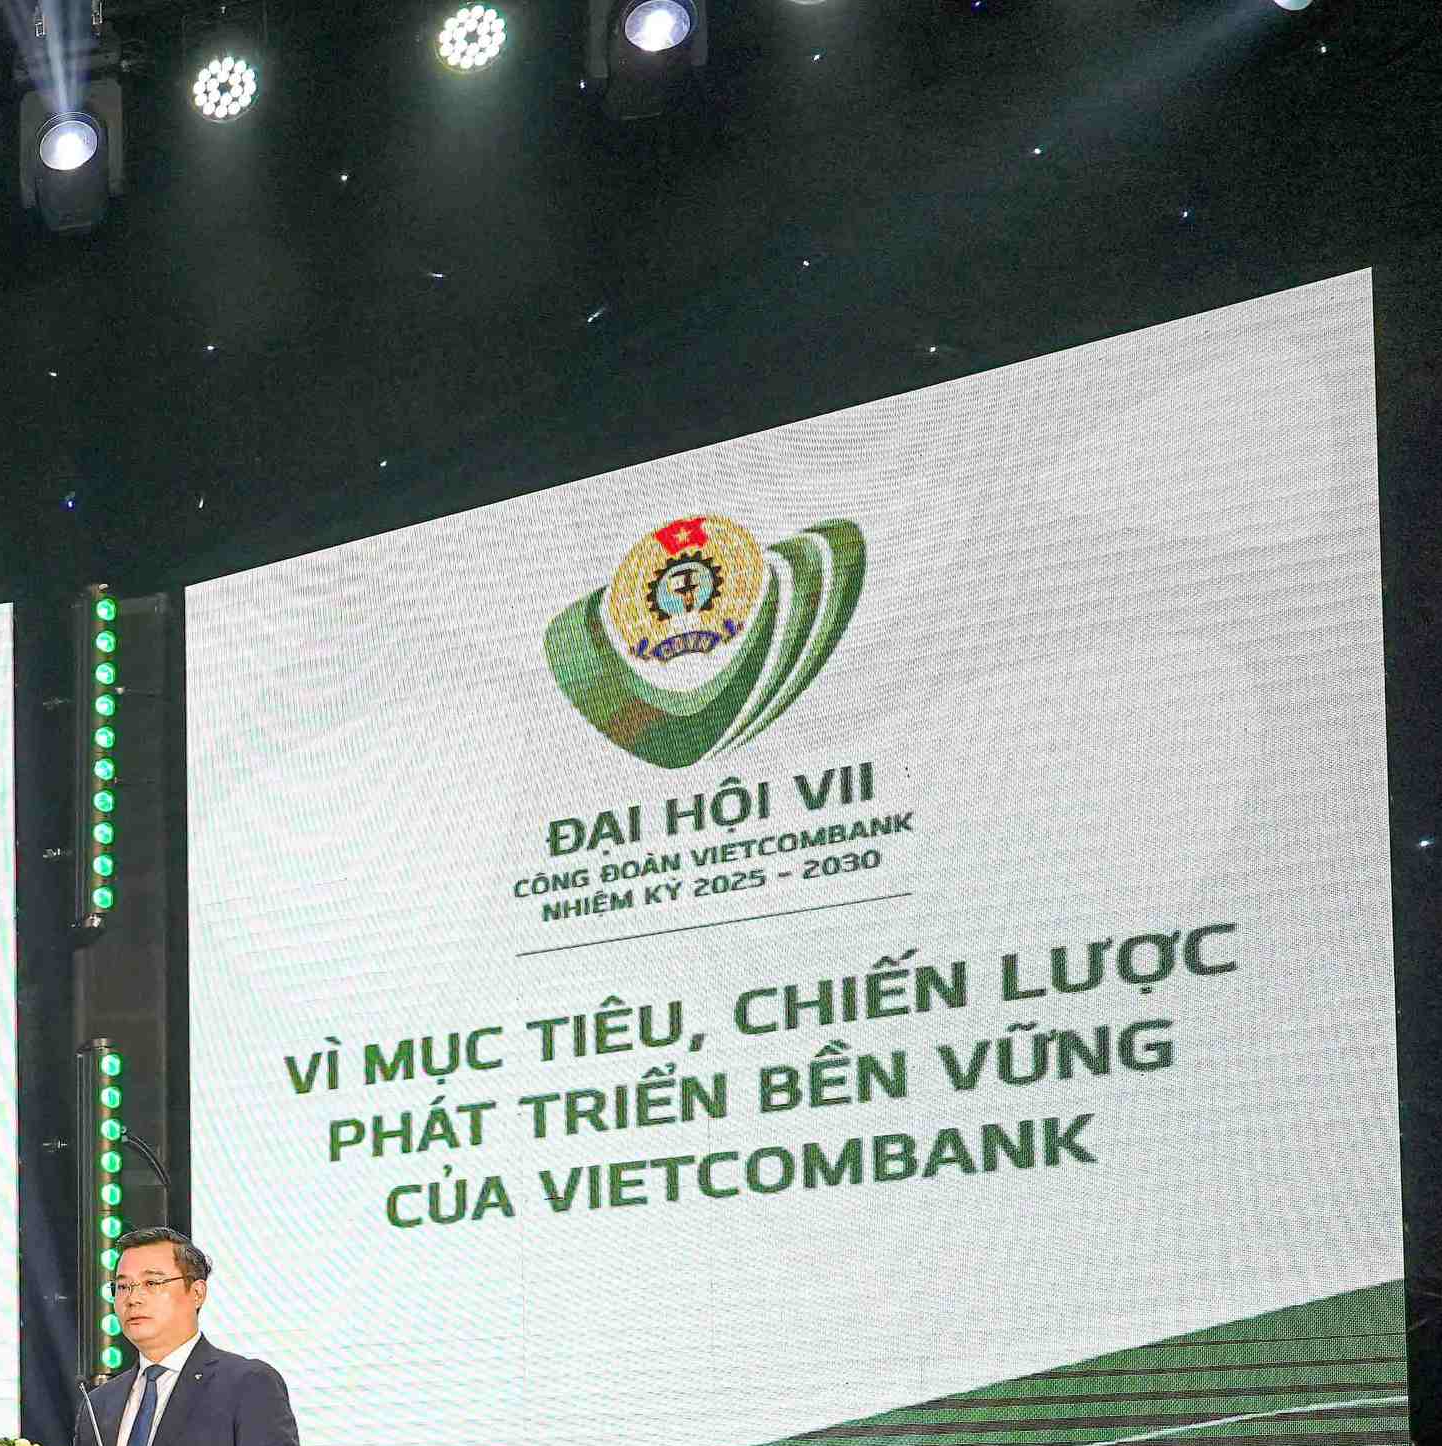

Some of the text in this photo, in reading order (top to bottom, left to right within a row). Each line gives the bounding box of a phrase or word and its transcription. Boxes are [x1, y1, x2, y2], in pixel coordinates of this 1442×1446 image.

[512, 811, 914, 899] CÔNG ĐOÀN VIETCOMBANK
[546, 762, 875, 855] ĐẠI HỘI VII
[541, 889, 634, 923] NHIỆM
[643, 880, 683, 906] KỲ
[692, 868, 767, 898] 2025
[801, 848, 883, 881] 2030
[284, 922, 1238, 1096] VÌ MỤC TIÊU, CHIẾN LƯỢC
[328, 1018, 1174, 1162] PHÁT TRIỂN BỀN VỮNG
[385, 1112, 1097, 1230] CỦA VIETCOMBANK
